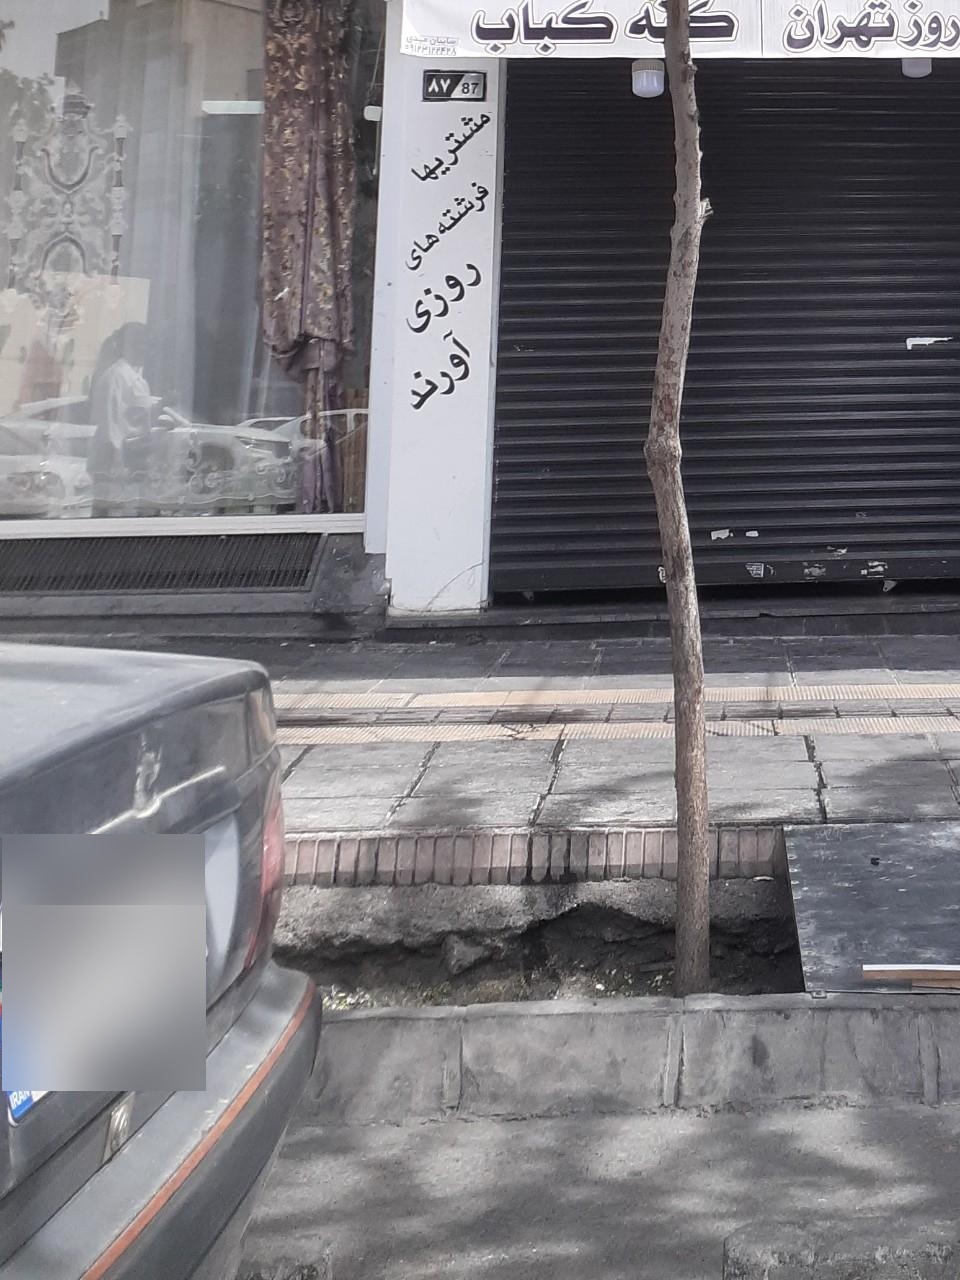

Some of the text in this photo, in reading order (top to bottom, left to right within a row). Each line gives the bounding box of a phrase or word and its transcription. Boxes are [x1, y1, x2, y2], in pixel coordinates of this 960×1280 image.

[427, 77, 451, 93] ۸۷
[461, 82, 480, 95] 87
[406, 263, 482, 333] روزی
[410, 329, 471, 410] آورند
